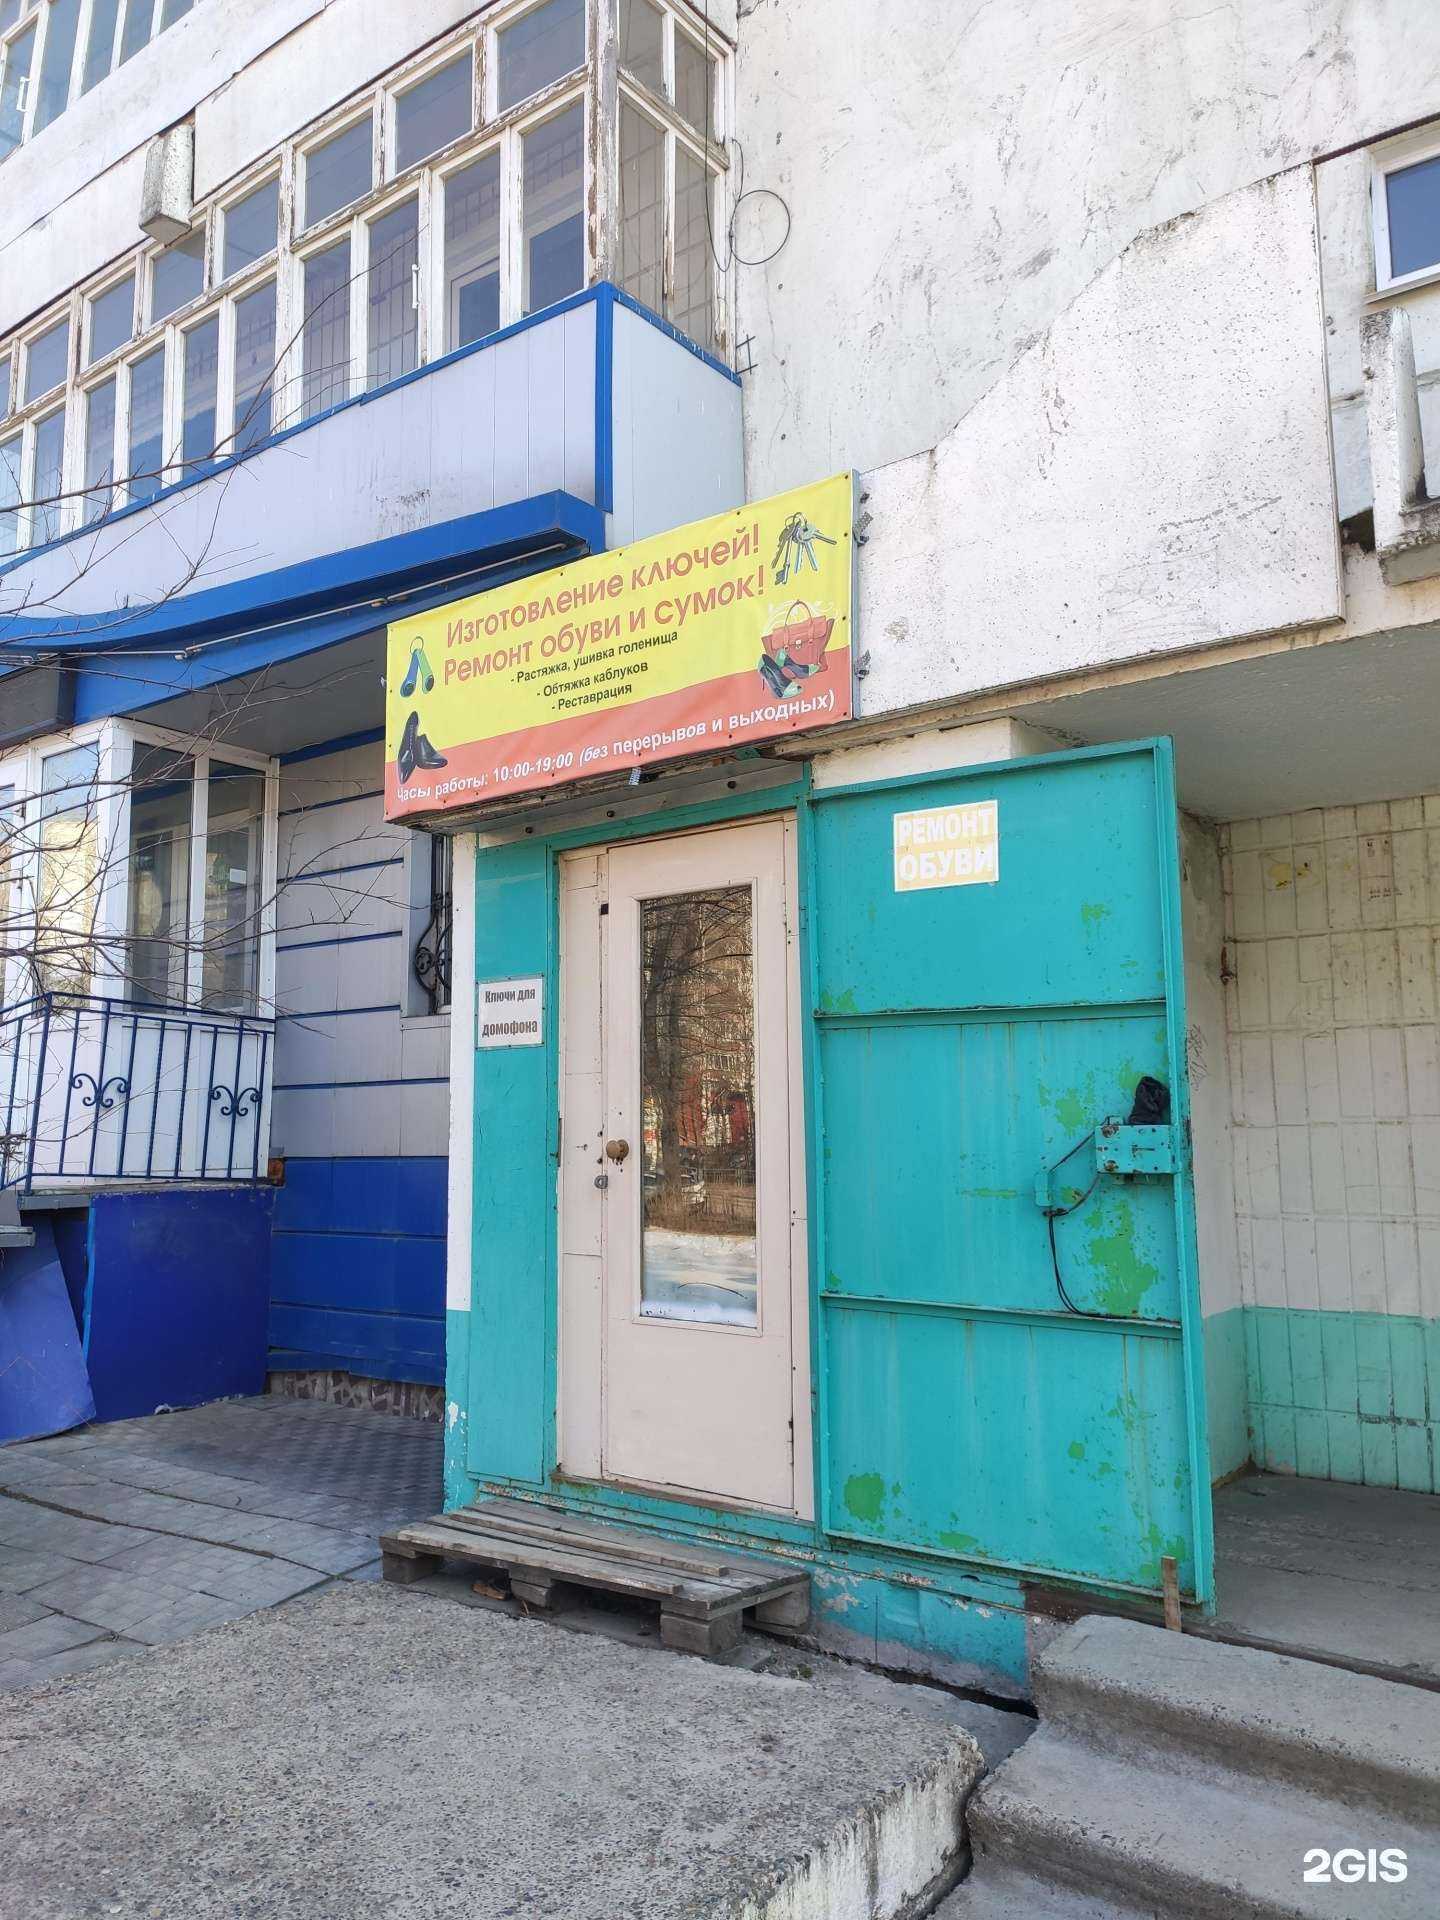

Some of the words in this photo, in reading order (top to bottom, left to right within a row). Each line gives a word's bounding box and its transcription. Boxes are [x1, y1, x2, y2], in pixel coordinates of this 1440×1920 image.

[447, 574, 624, 648] Изготовление
[631, 524, 760, 590] ключей!
[444, 641, 532, 686] Ремонт
[541, 616, 620, 658] обуви
[630, 611, 645, 633] и
[654, 565, 764, 625] сумок!
[517, 660, 570, 682] Растяжка,
[573, 648, 615, 670] ушивка
[618, 632, 678, 656] голенища
[543, 677, 591, 697] Обтяжка
[593, 662, 648, 684] каблуков
[558, 684, 632, 710] Реставрация
[435, 774, 488, 798] работы:
[492, 752, 573, 782] 10:00-19:00
[579, 748, 607, 768] (без
[613, 722, 706, 757] перерывов
[712, 719, 722, 733] и
[729, 689, 834, 729] выходных)
[899, 808, 993, 846] РЕМОНТ
[900, 841, 993, 881] ОБУВИ
[485, 990, 516, 1003] Ключи
[517, 988, 535, 1003] для
[482, 1020, 538, 1038] домофона
